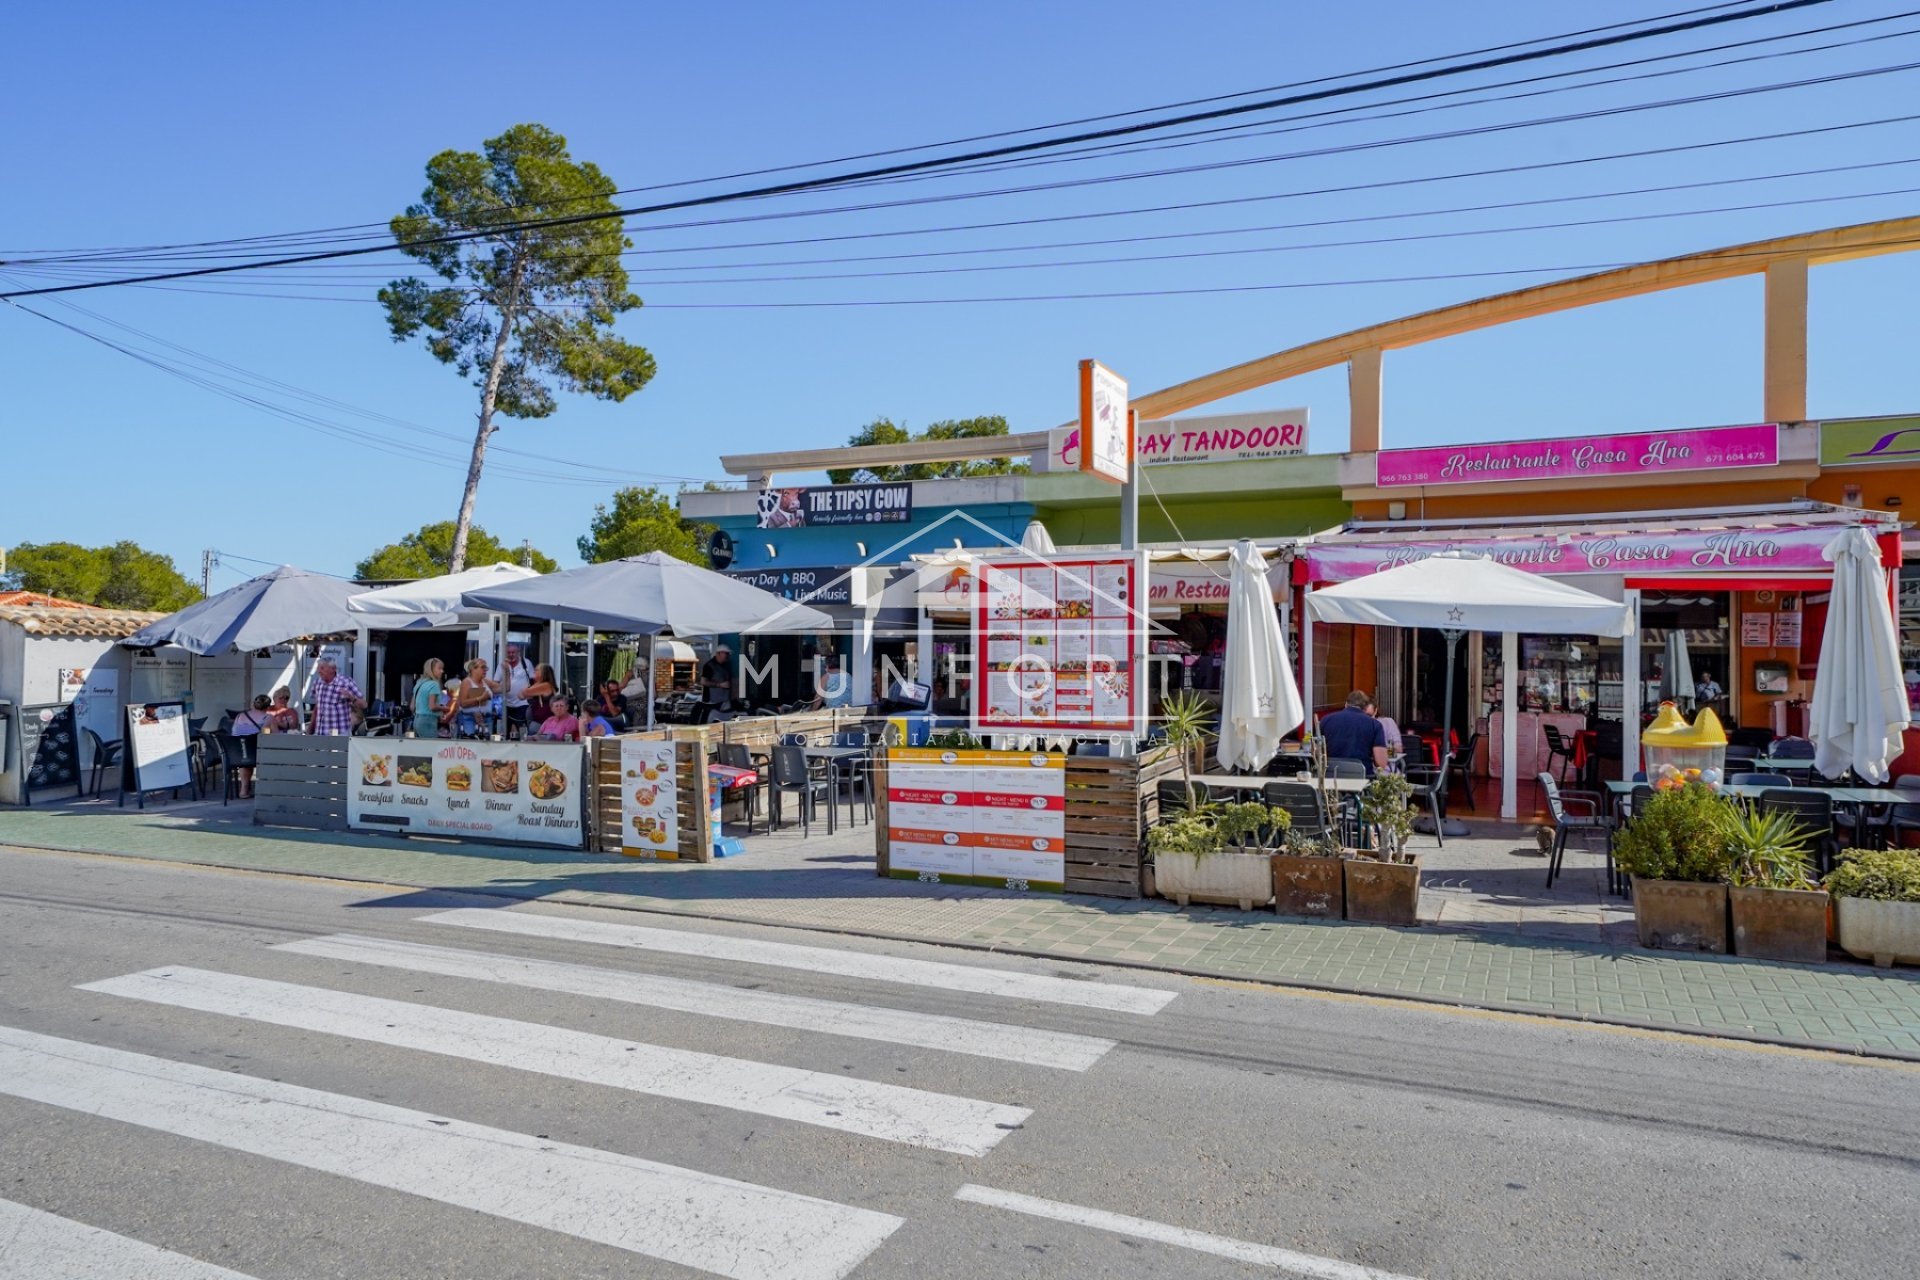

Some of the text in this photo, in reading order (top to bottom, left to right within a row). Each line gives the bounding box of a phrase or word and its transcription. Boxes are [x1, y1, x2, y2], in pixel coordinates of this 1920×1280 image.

[1181, 424, 1303, 452] TANDOORI
[1440, 440, 1692, 477] Restaurante Casa Ana
[1705, 451, 1765, 463] 671 604 475
[1381, 474, 1396, 482] 966
[1399, 473, 1412, 481] 763
[808, 487, 908, 512] THE TIPSY COW
[1375, 533, 1781, 574] Rerante Casa Ana
[759, 573, 780, 587] Day
[792, 572, 816, 586] BBQ
[795, 589, 815, 601] Live
[817, 589, 848, 601] Music
[1175, 580, 1231, 599] Restau
[437, 746, 477, 760] NOW OPEN
[358, 791, 394, 806] Breakfast
[400, 793, 428, 807] Snacks
[446, 796, 471, 811] Lunch
[484, 798, 514, 812] Dinner
[530, 801, 565, 818] Sunday
[427, 818, 493, 832] DAILY SPECIAL BOARD
[517, 813, 579, 829] Roast Dinners
